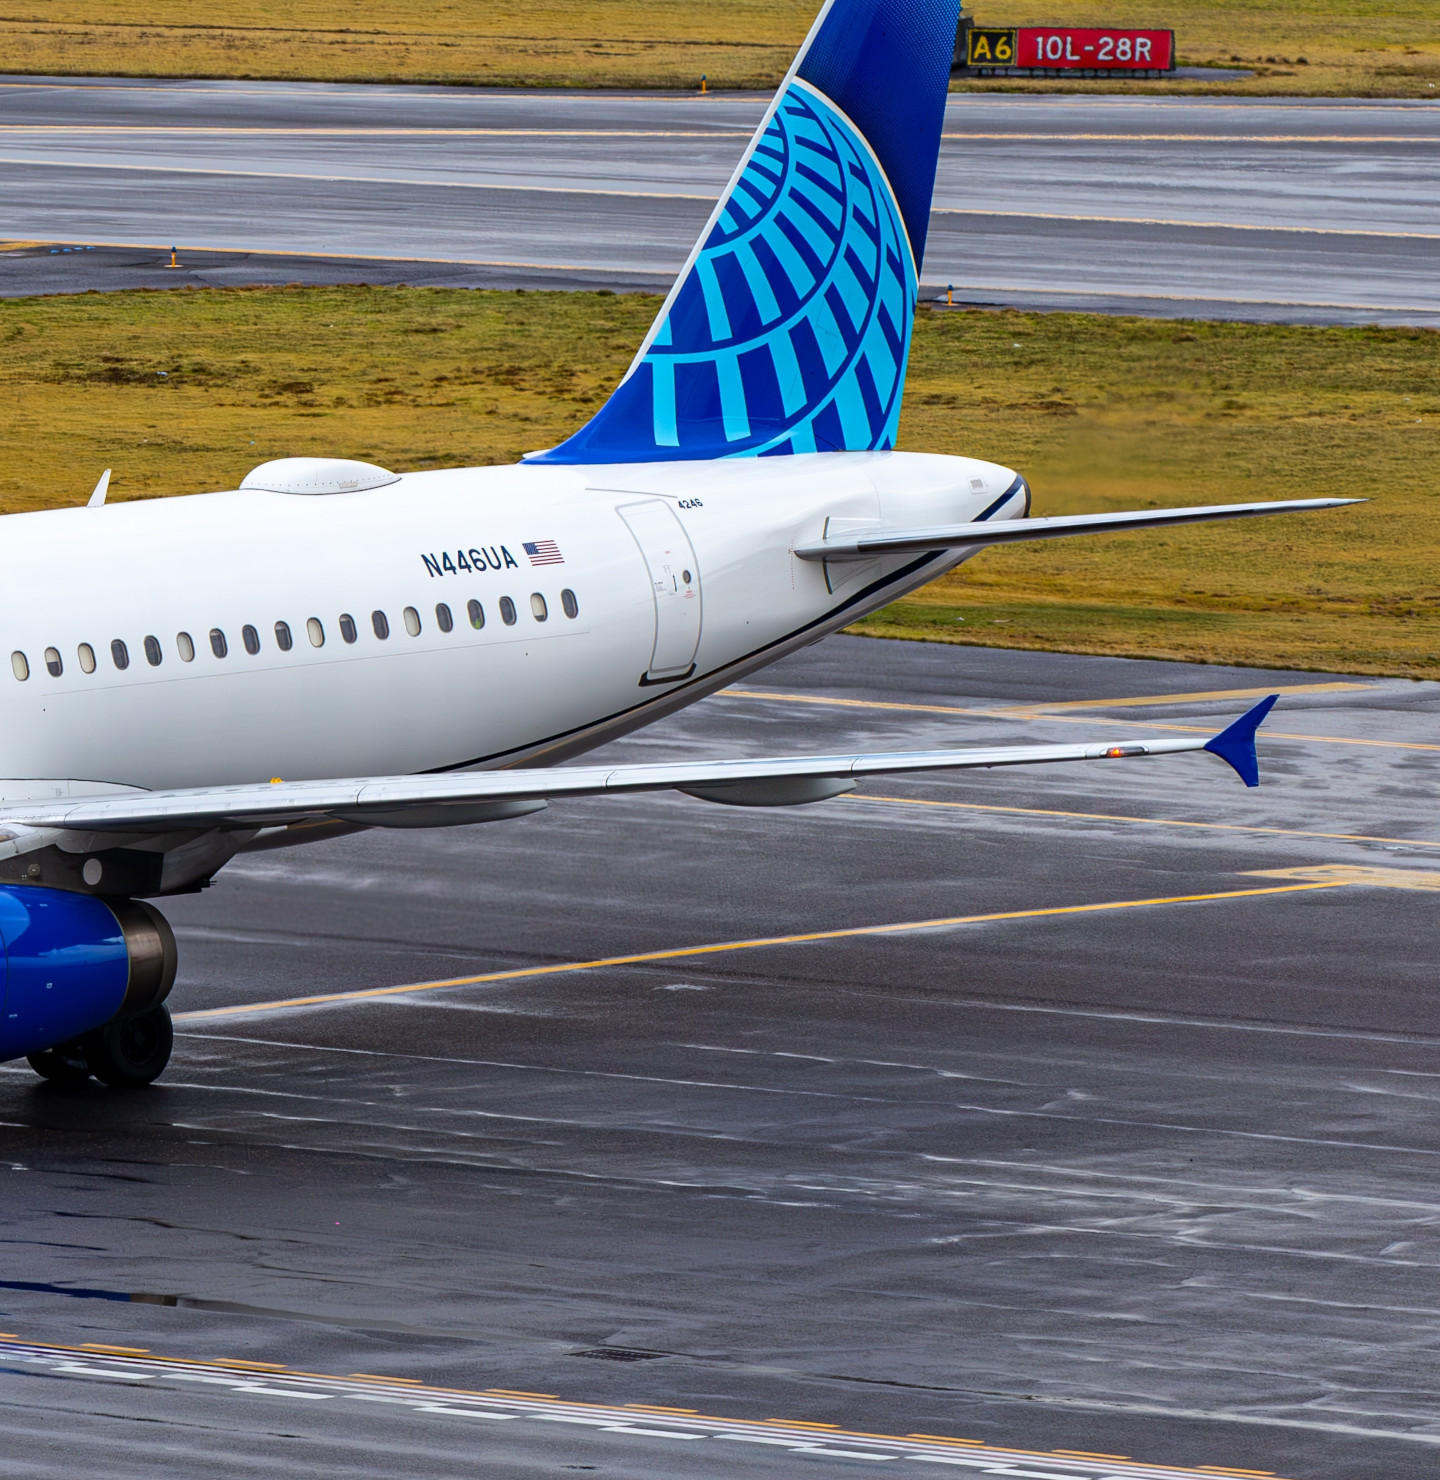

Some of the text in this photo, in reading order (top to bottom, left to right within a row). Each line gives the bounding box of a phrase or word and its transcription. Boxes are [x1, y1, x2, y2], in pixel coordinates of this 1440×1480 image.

[973, 35, 1153, 62] A6 10L-28R
[678, 498, 704, 509] 4246
[421, 545, 519, 578] N446UA
